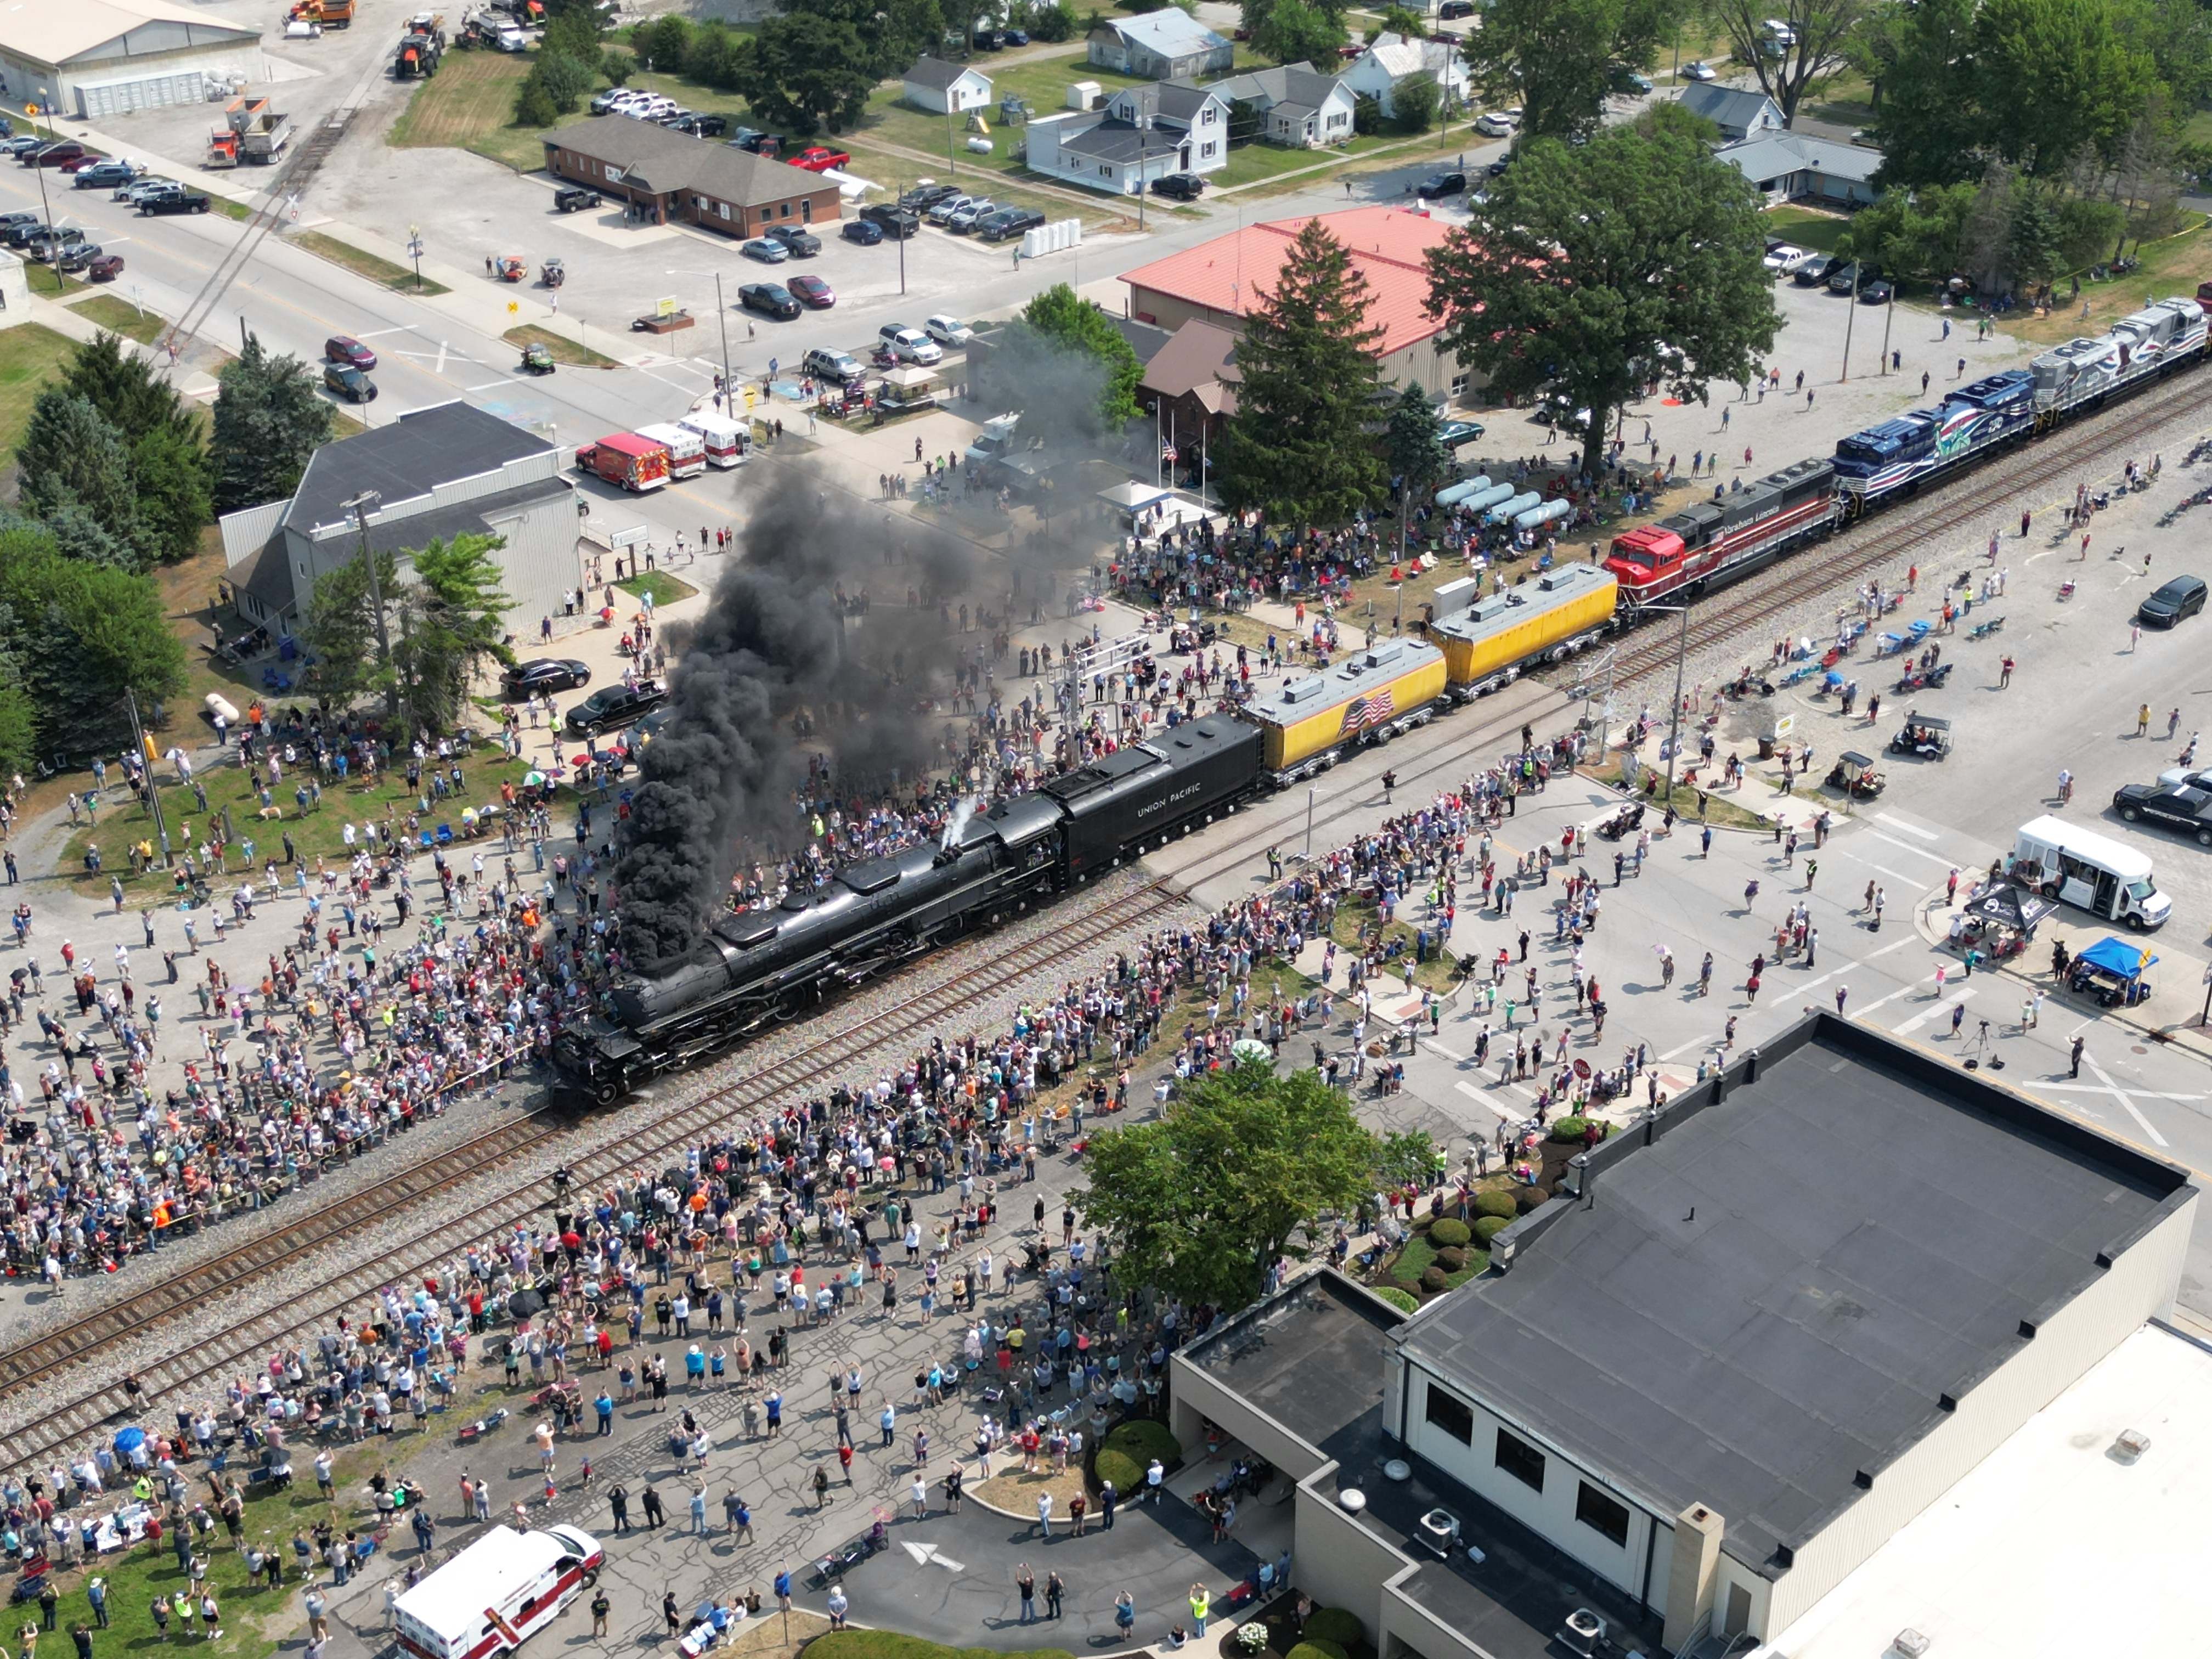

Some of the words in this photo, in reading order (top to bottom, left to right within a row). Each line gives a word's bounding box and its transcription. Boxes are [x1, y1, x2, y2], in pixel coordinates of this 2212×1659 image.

[1138, 798, 1166, 817] UNION
[1170, 783, 1200, 802] PACIFIC
[1575, 1062, 1590, 1074] STOP
